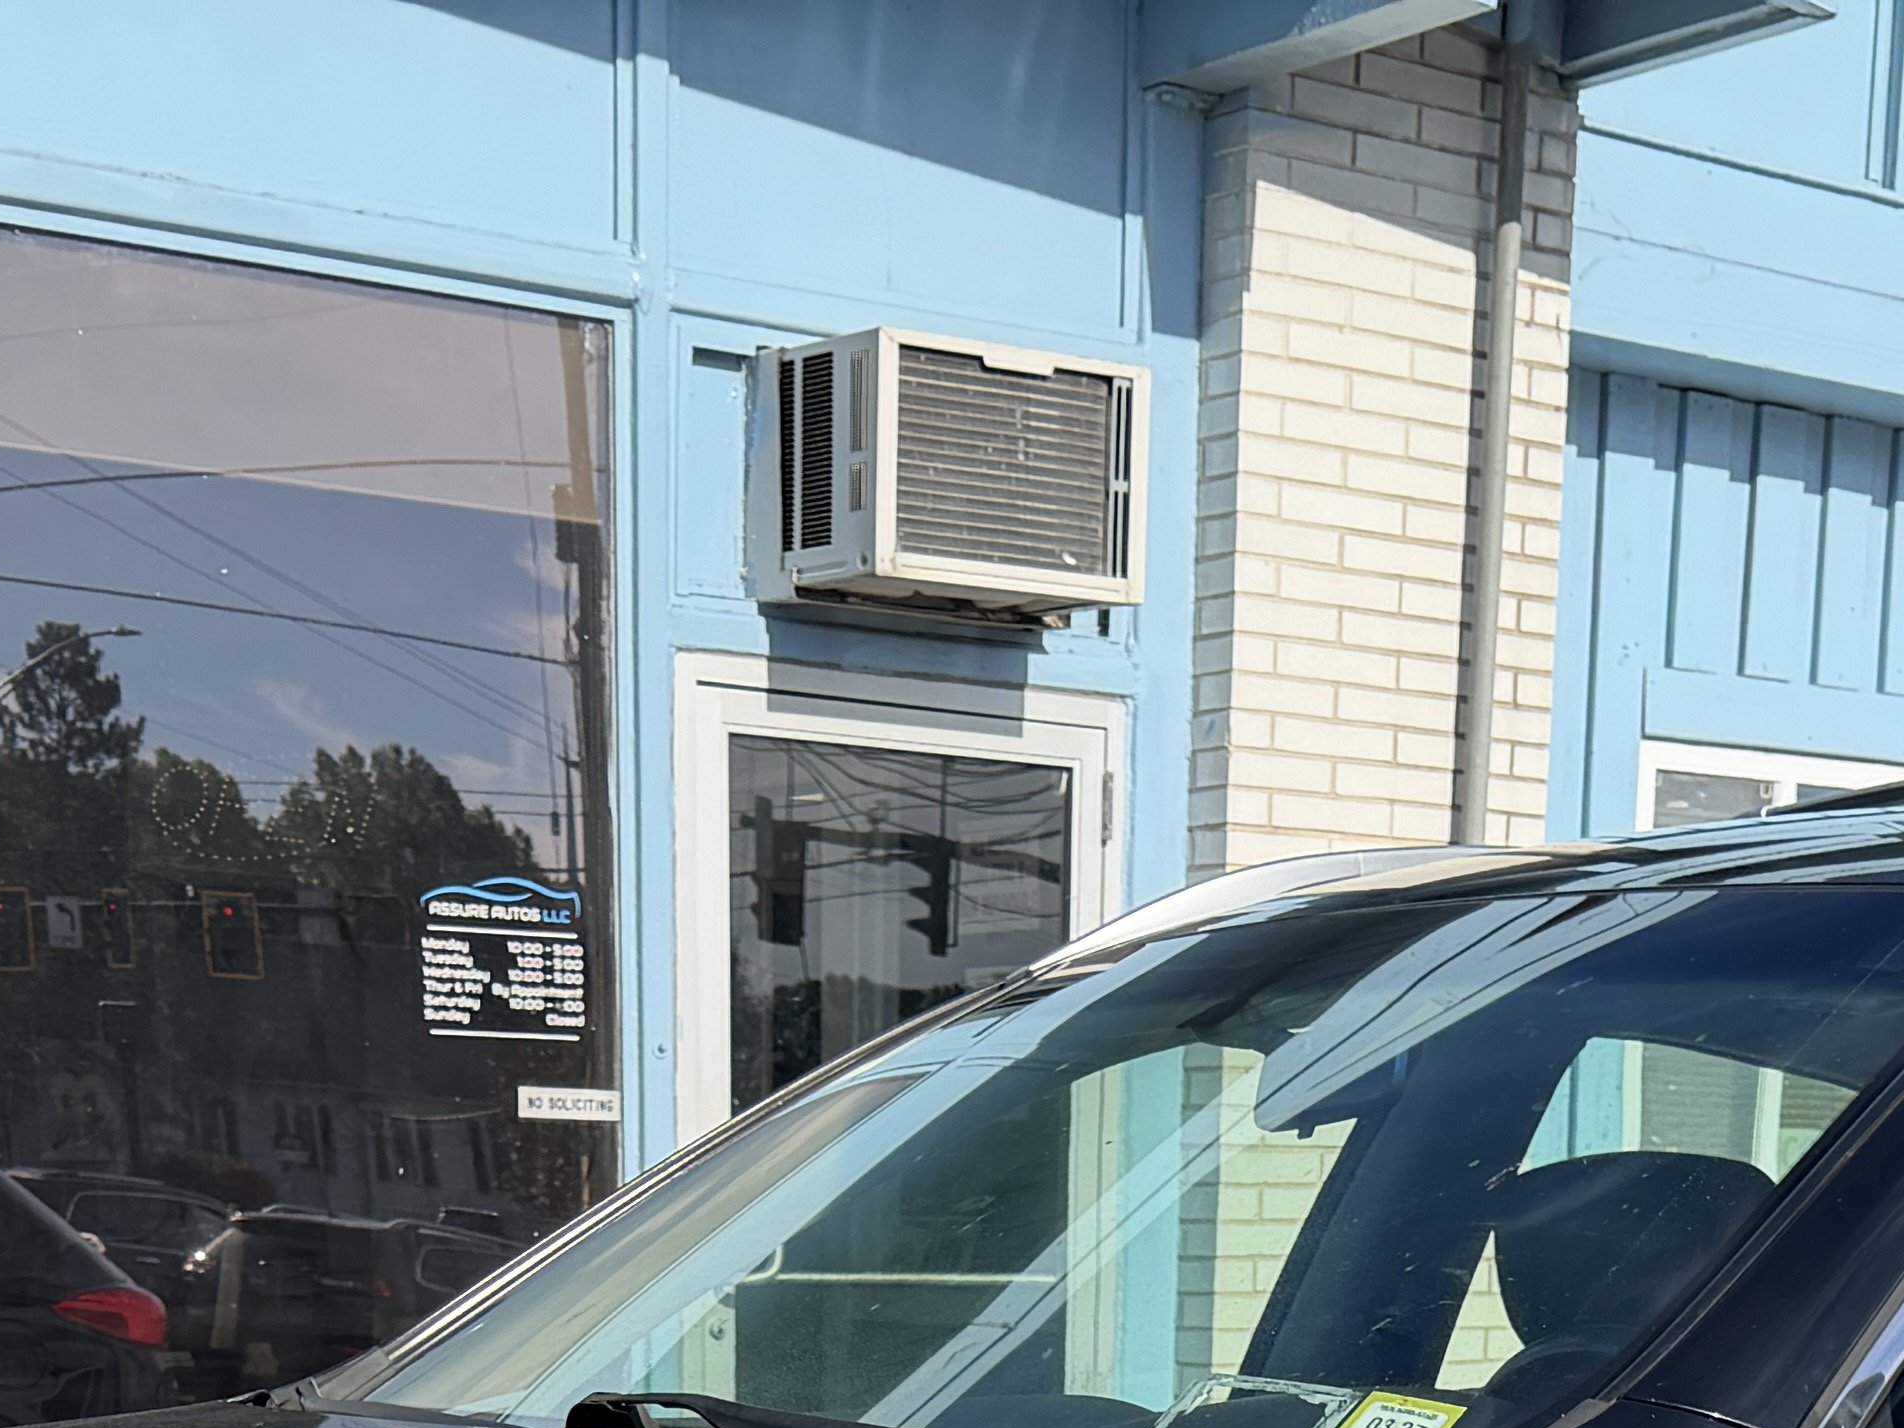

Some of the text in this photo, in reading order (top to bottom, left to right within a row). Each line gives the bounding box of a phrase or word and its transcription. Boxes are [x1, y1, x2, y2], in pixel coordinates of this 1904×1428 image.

[429, 901, 571, 924] ASSURE AUTOS LLC
[421, 937, 470, 954] Monday
[507, 941, 544, 955] 10:00
[552, 943, 584, 957] 5:00
[422, 951, 474, 968] Tuesday
[552, 957, 584, 971] 5:00
[422, 966, 491, 983] Wednesday
[508, 969, 544, 983] 10:00
[553, 971, 585, 985] 5:00
[491, 983, 510, 999] By
[511, 984, 584, 999] Appointment
[423, 993, 481, 1011] Saturday
[423, 1008, 586, 1028] Sunday Closed
[527, 1096, 614, 1113] NO SOLICITING
